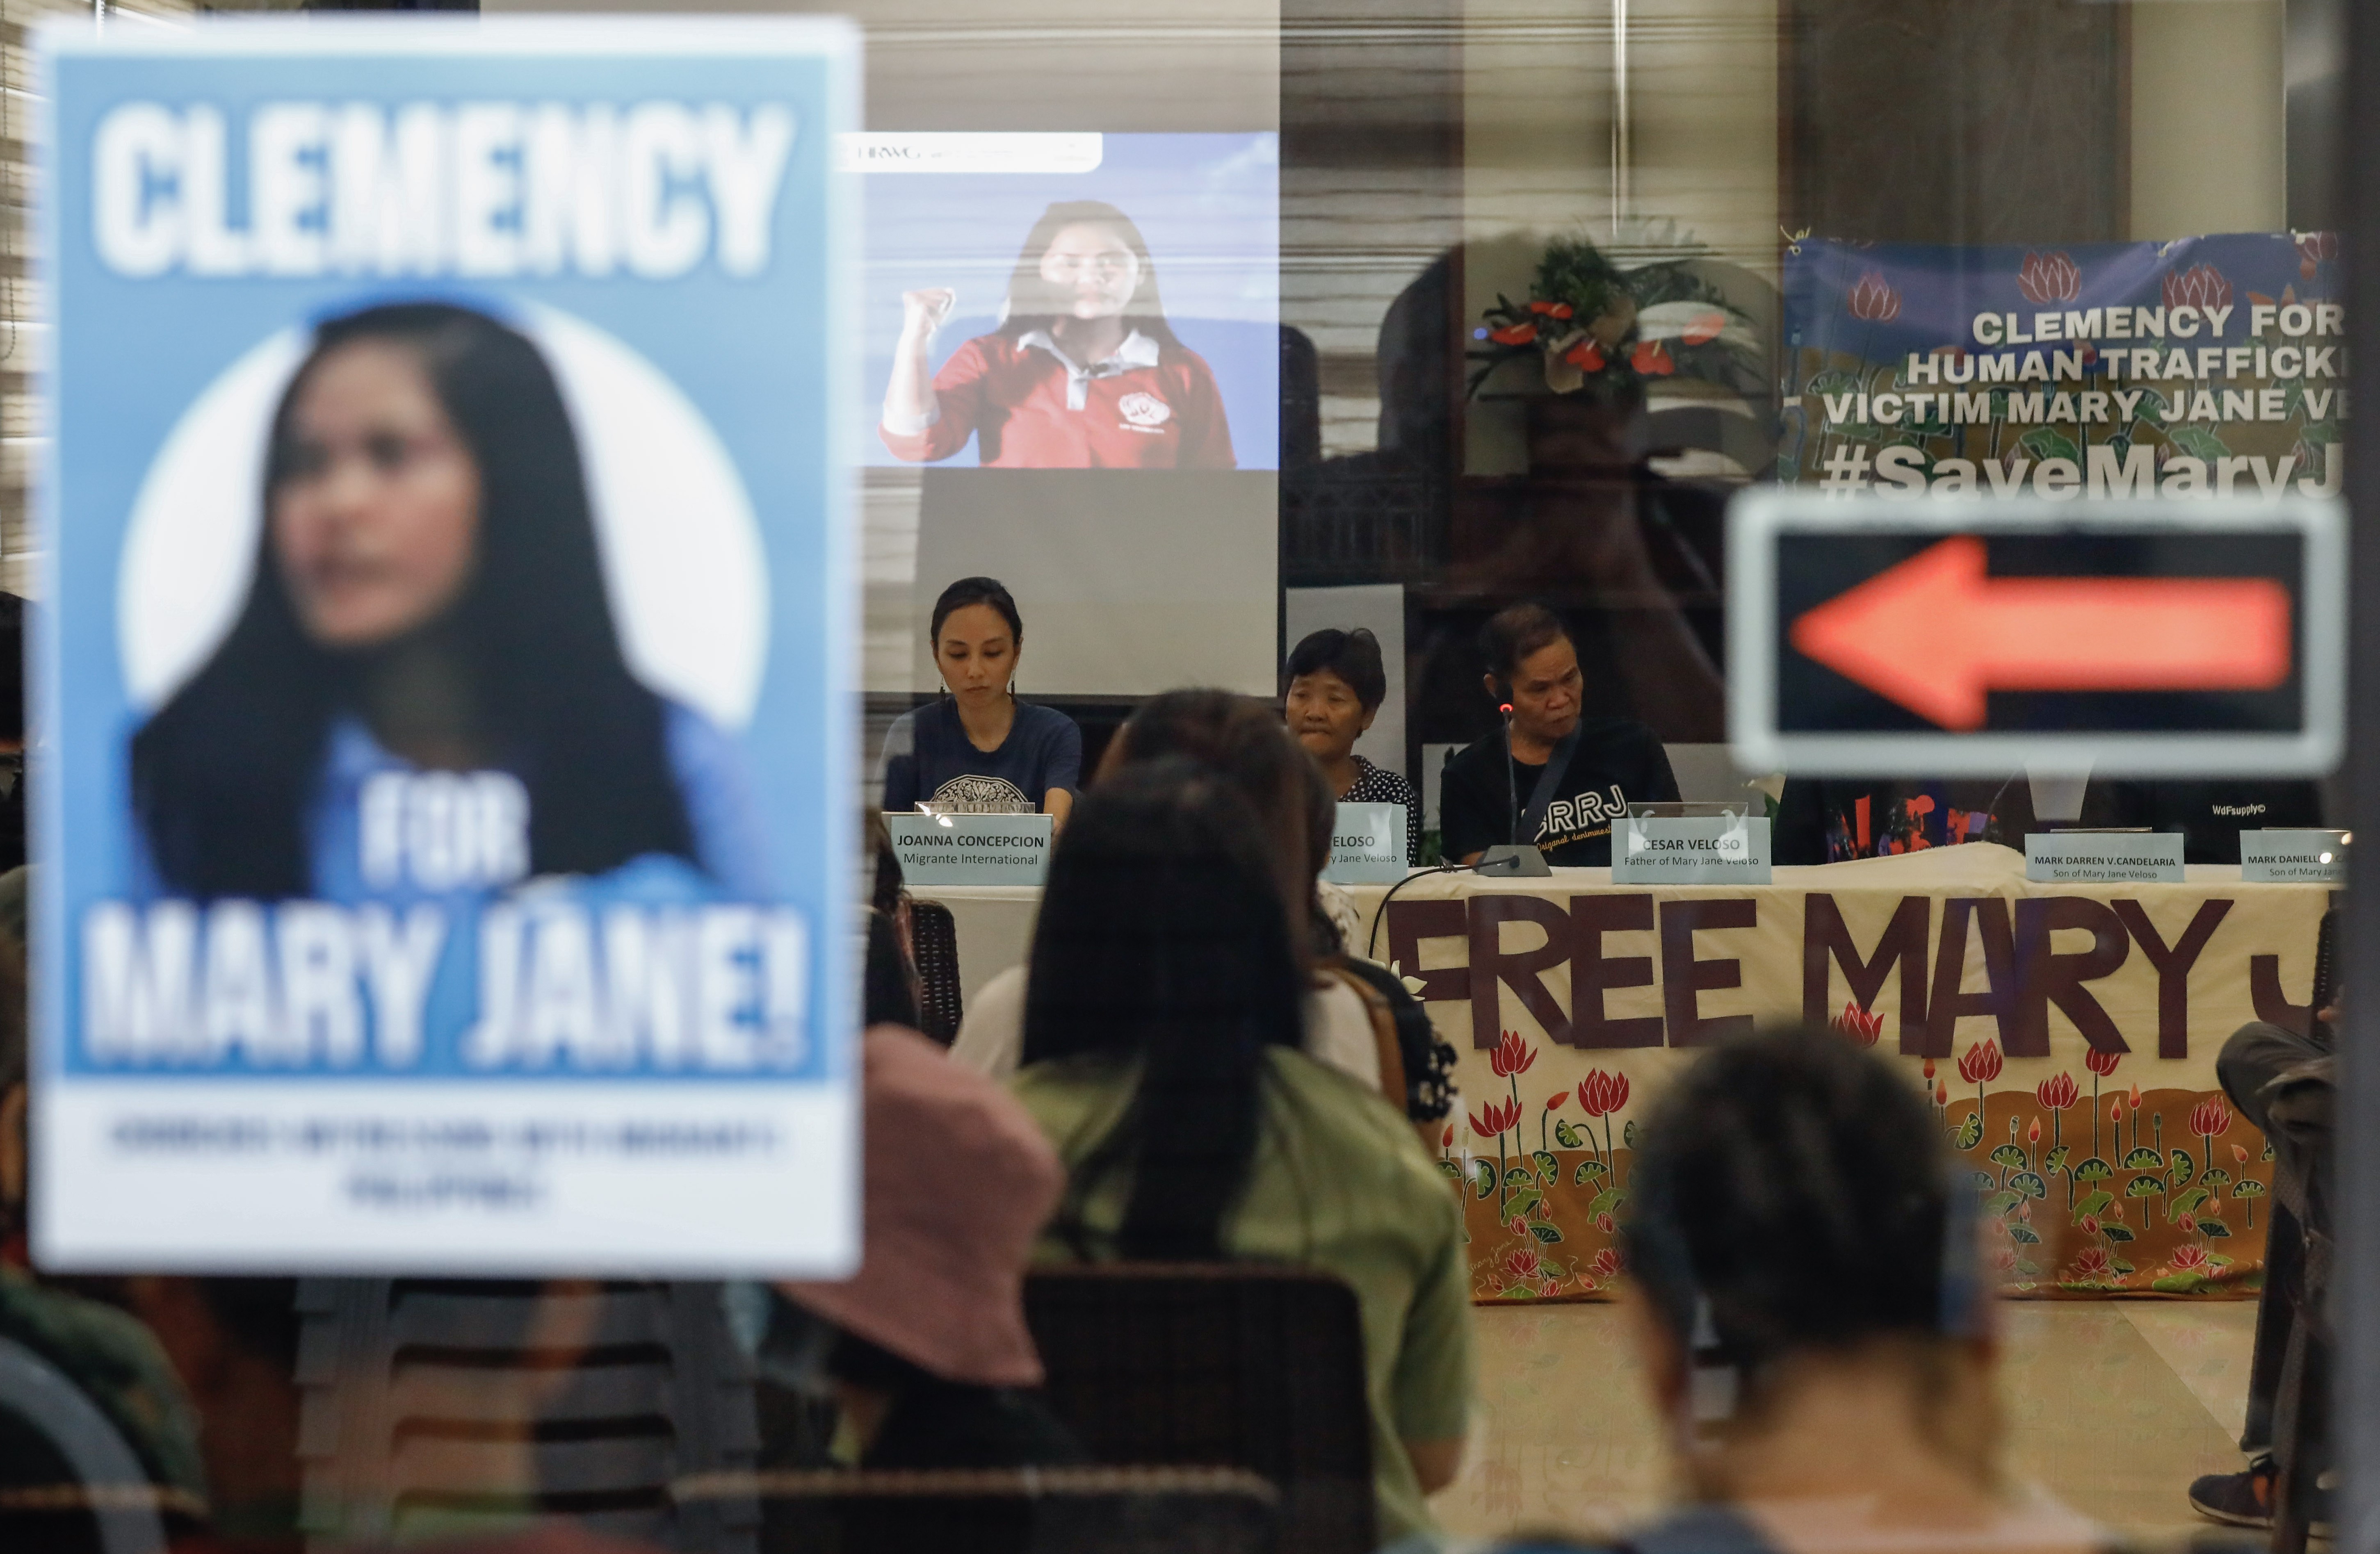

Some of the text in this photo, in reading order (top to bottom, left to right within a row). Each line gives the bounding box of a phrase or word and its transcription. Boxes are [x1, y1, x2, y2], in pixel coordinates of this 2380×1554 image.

[91, 100, 795, 278] CLEMENCY
[1972, 304, 2345, 345] CLEMENCY FOR
[1907, 350, 2083, 384] HUMAN
[1822, 392, 1990, 424] VICTIM
[2008, 390, 2142, 423] MARY
[2159, 388, 2286, 422] JANE
[359, 770, 529, 887] FOR
[897, 835, 1044, 848] JOANNA CONCEPCION
[1332, 836, 1375, 847] ELOSO
[1643, 839, 1740, 850] CESAR VELOSO
[904, 853, 1038, 866] Migrante International
[1339, 854, 1361, 863] Jane
[1364, 853, 1397, 863] Veloso
[1625, 856, 1759, 867] Father of Mary Jane Veloso
[2035, 856, 2176, 866] MARK DARREN V.CANDELARIA
[2248, 855, 2321, 864] MARK DANIELL
[2054, 869, 2157, 879] Son of Mary Jane Veloso
[2270, 868, 2285, 876] Son
[2288, 868, 2297, 876] of
[2299, 868, 2321, 877] Mary
[1386, 893, 1757, 1050] FREE
[1802, 893, 2234, 1059] MARY
[82, 899, 808, 1069] MARY JANE!
